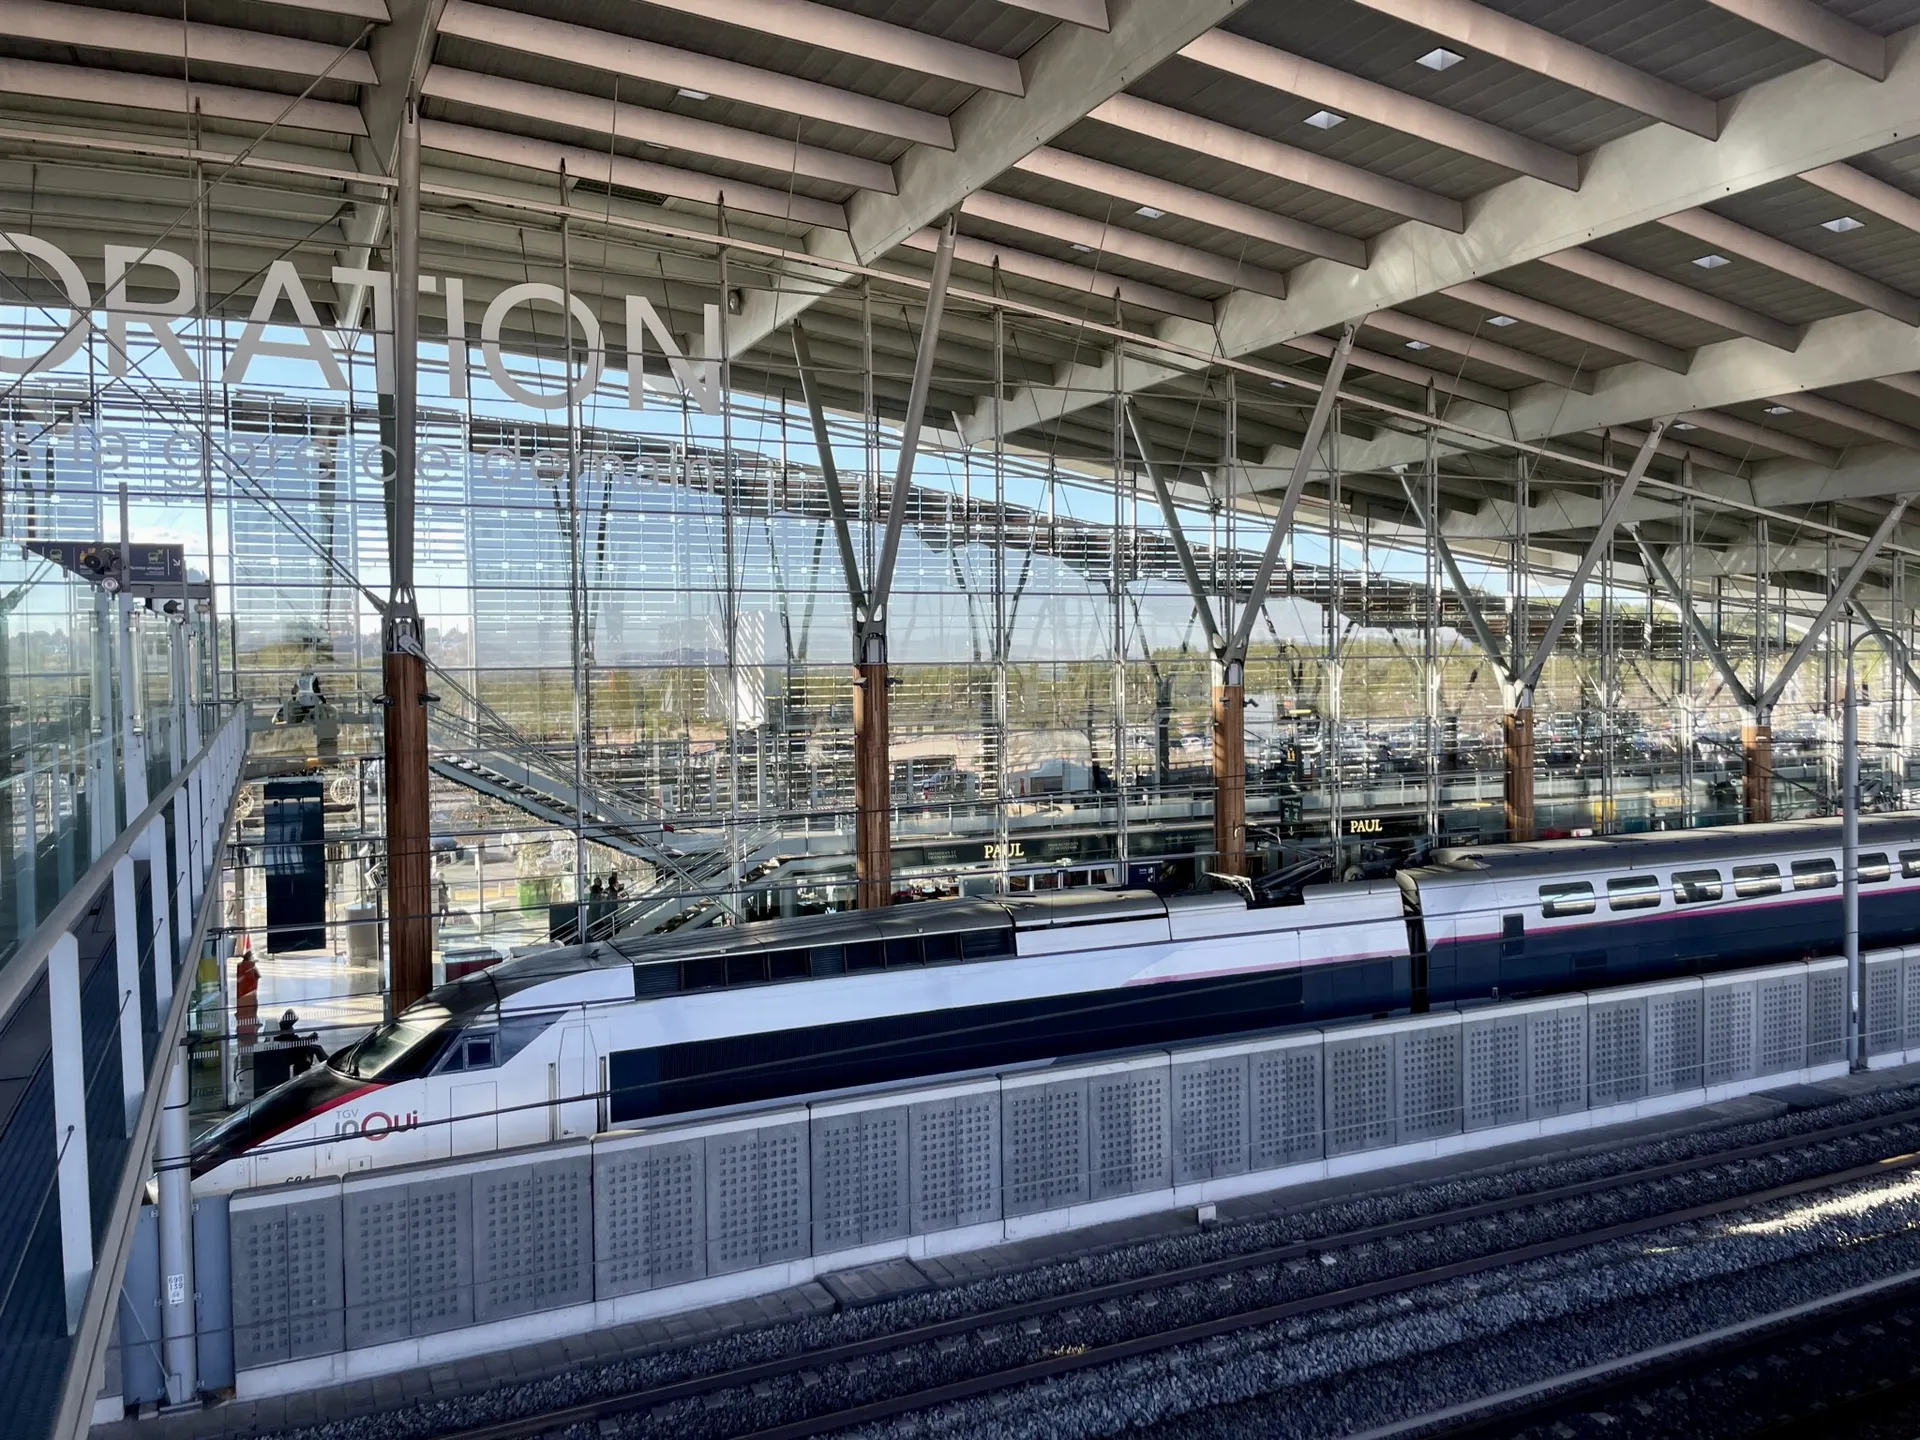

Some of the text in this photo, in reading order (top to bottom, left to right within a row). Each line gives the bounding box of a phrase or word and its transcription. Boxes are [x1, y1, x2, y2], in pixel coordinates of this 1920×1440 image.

[72, 407, 129, 471] la
[163, 430, 334, 490] gare
[482, 427, 717, 495] demain
[1350, 818, 1383, 833] PAUL
[984, 842, 1025, 859] PAUL
[335, 1108, 360, 1119] TGV
